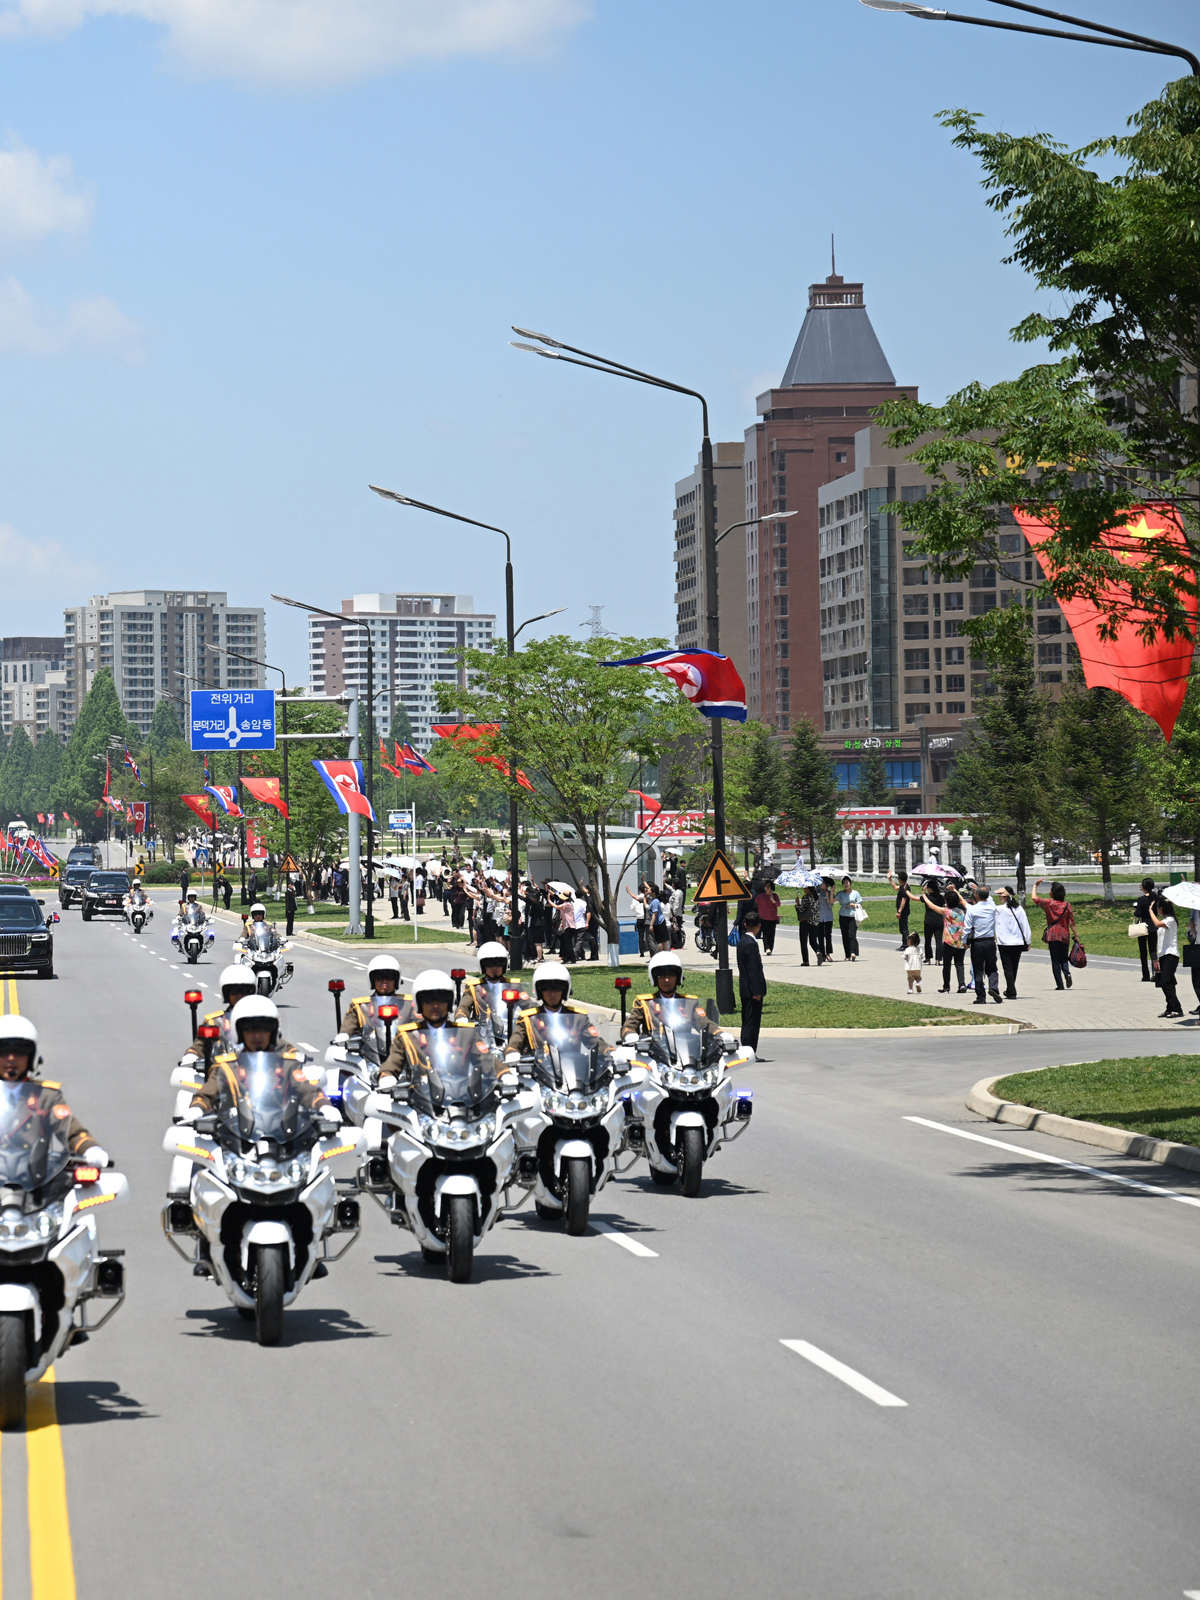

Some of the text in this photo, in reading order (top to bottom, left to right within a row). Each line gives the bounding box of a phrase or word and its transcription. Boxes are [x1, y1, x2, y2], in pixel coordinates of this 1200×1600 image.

[210, 693, 254, 704] 전위거리
[240, 719, 272, 730] 송암동
[844, 740, 861, 749] 화성
[885, 739, 901, 748] 상점
